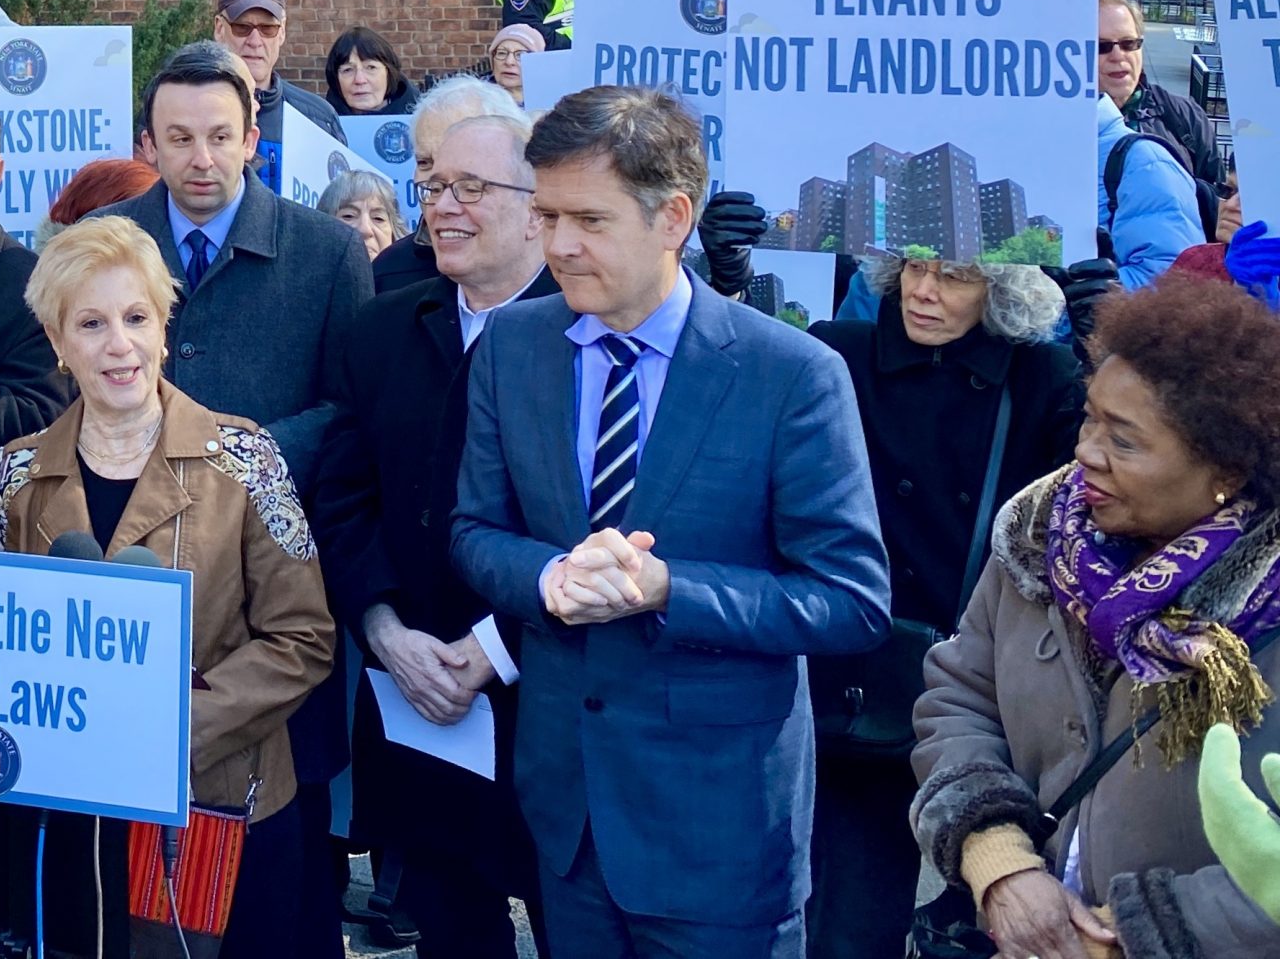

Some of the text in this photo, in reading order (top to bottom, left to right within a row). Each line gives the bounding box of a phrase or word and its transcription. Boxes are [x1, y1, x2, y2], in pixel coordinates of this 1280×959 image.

[594, 42, 727, 97] PROTEC
[735, 37, 1096, 99] NOT LANDLORDS!
[66, 597, 150, 666] New
